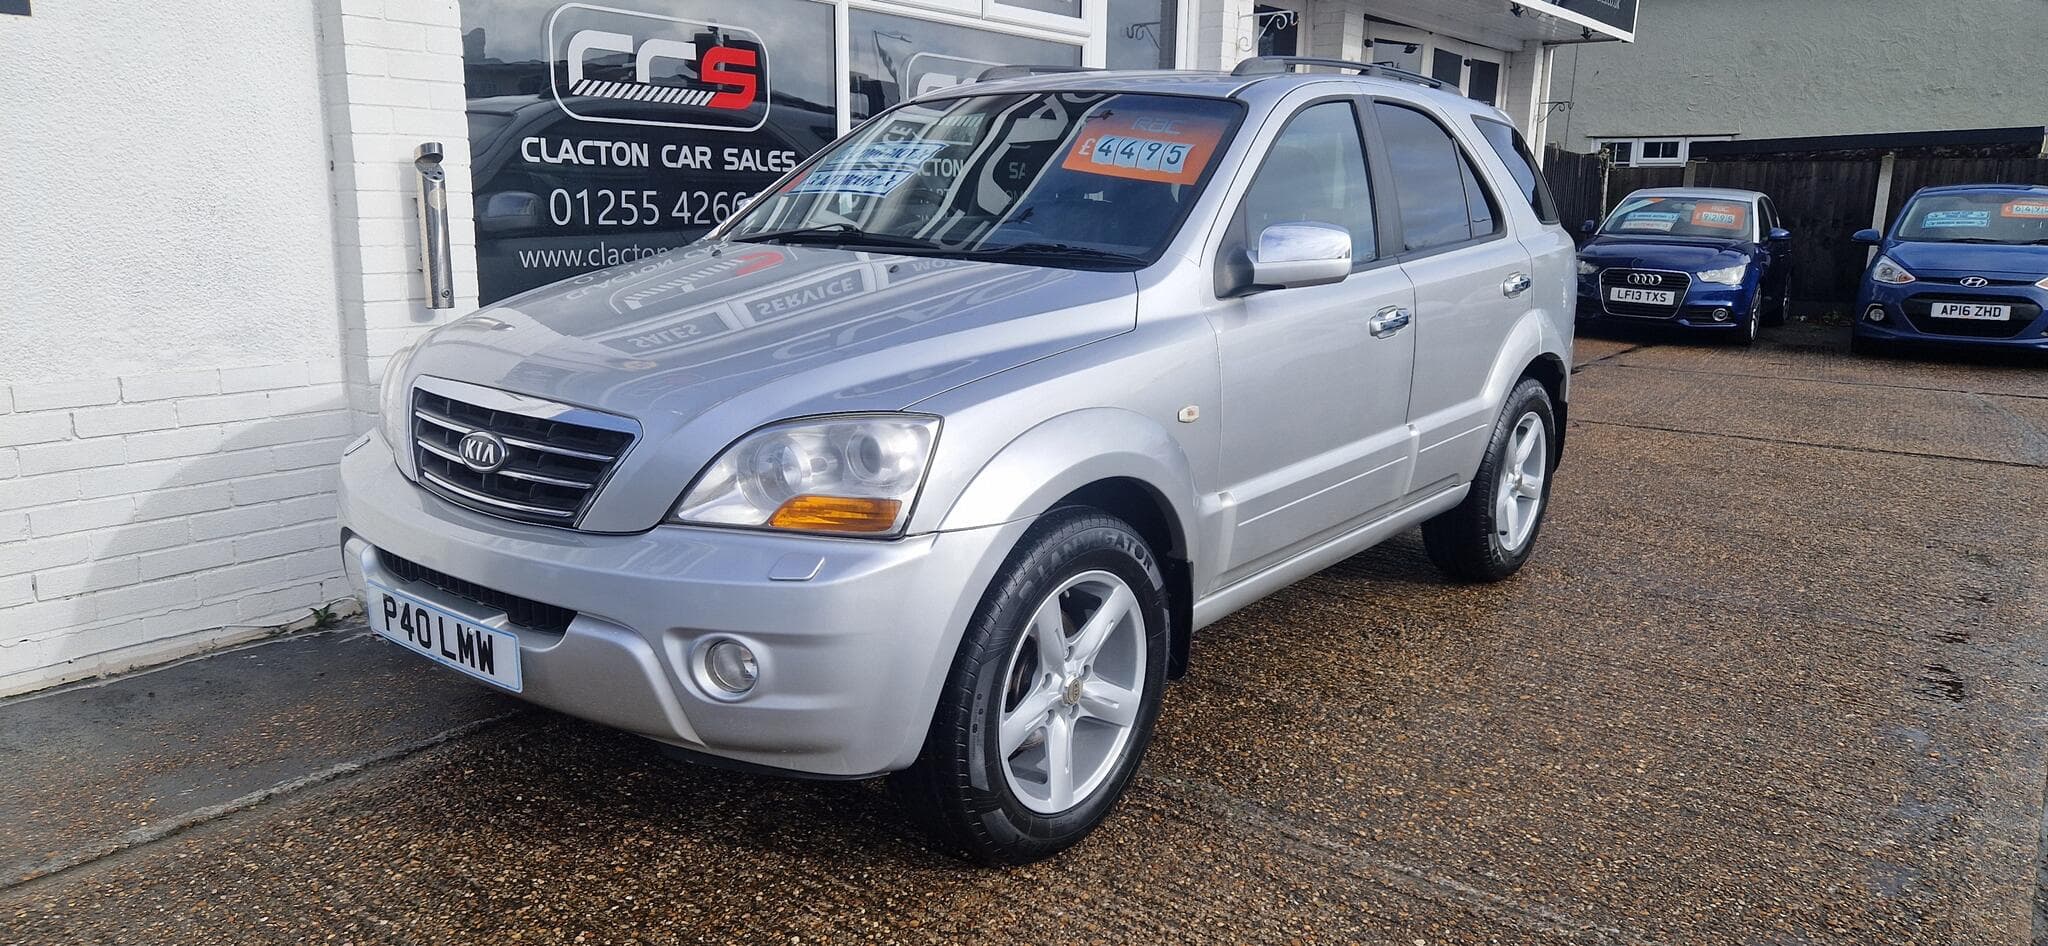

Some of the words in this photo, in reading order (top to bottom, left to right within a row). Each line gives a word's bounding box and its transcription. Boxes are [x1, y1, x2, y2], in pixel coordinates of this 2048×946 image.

[520, 136, 650, 168] CLACTON
[661, 144, 712, 170] CAR
[723, 147, 797, 173] SALES
[549, 187, 660, 226] 01255
[1617, 289, 1644, 302] LF13
[1645, 291, 1667, 303] TXS
[1940, 304, 1971, 316] AP16
[1974, 305, 2002, 318] ZHD
[464, 438, 496, 465] KIA
[382, 593, 432, 650] P40
[438, 615, 496, 677] LMW
